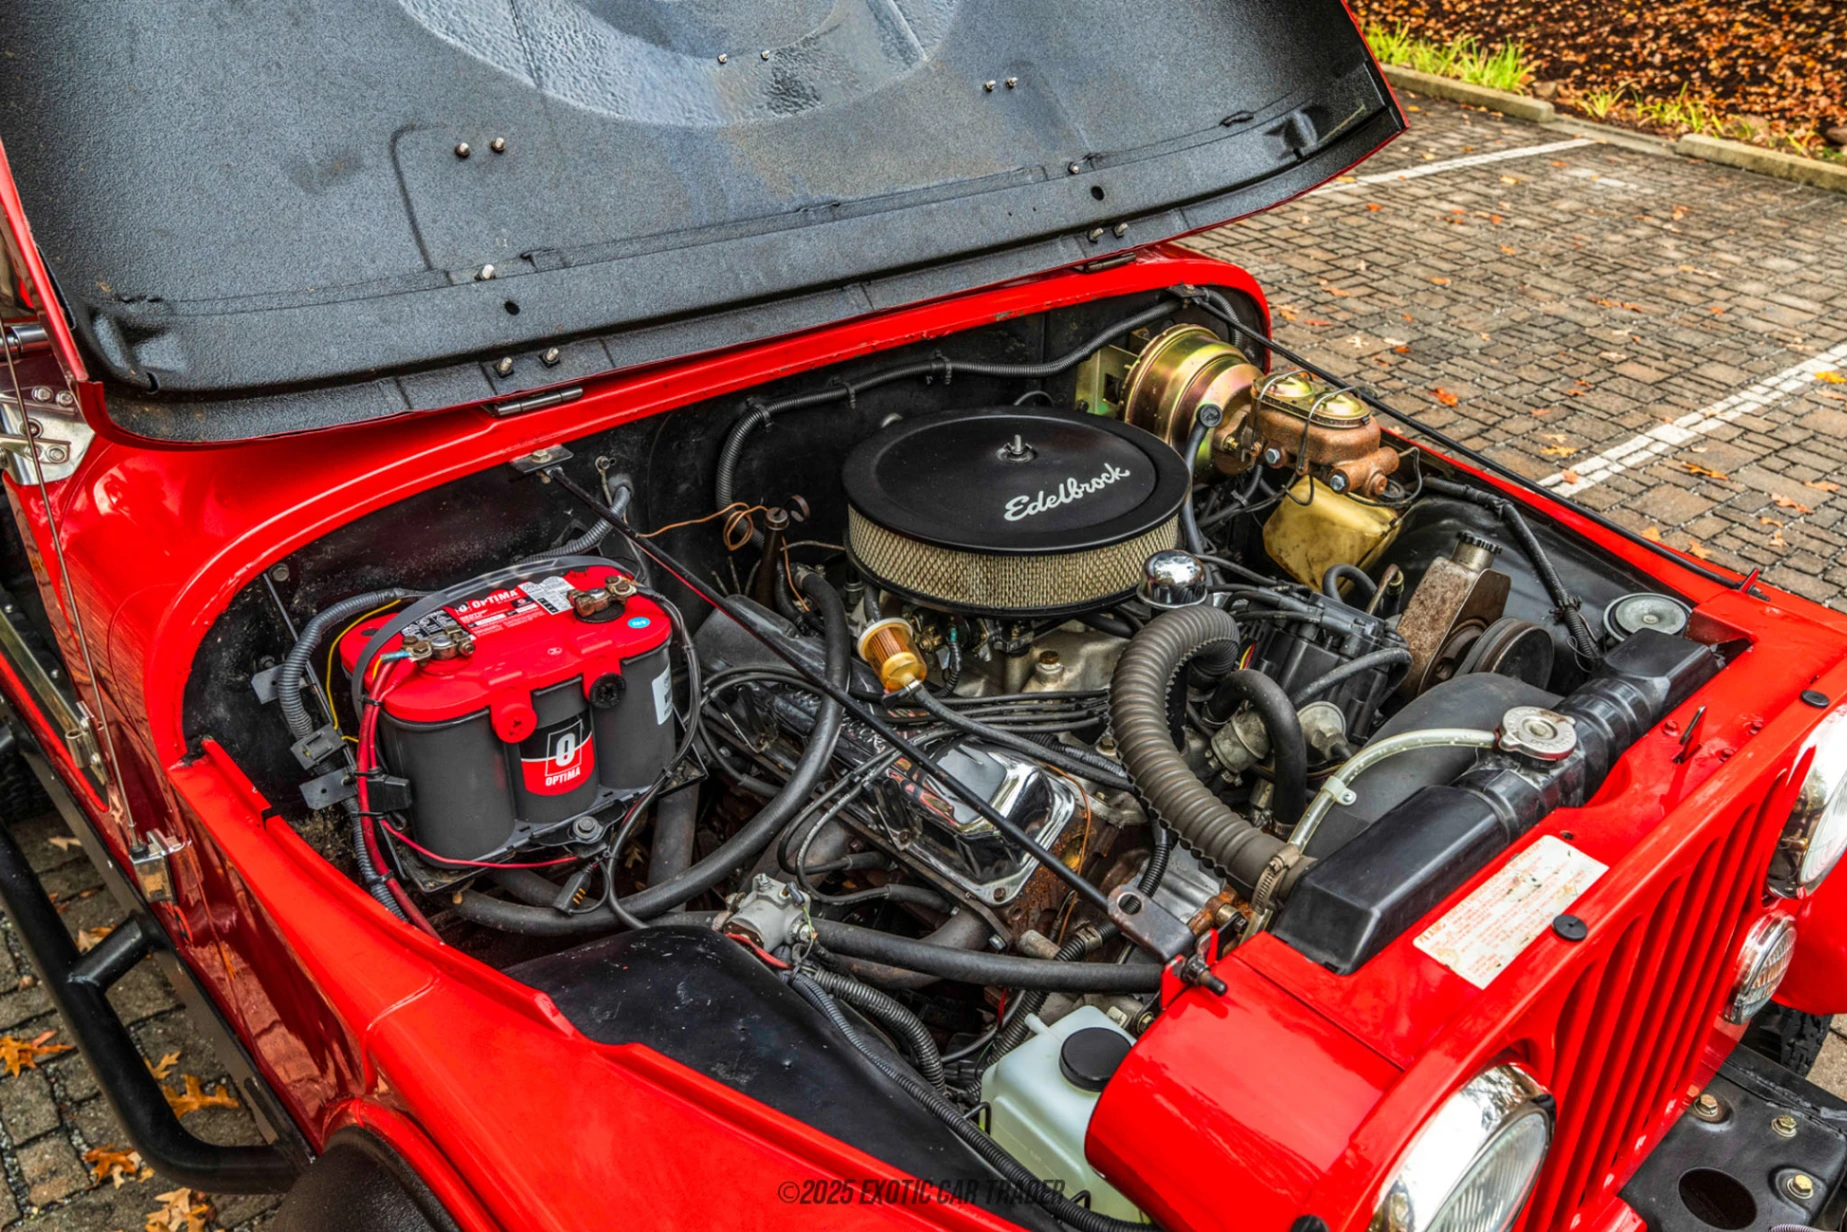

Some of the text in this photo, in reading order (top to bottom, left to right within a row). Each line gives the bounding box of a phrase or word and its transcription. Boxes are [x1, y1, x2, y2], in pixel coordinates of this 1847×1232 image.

[1004, 463, 1131, 521] Edelbrock
[472, 590, 518, 608] OPTIMA
[545, 766, 581, 786] OPTIMA
